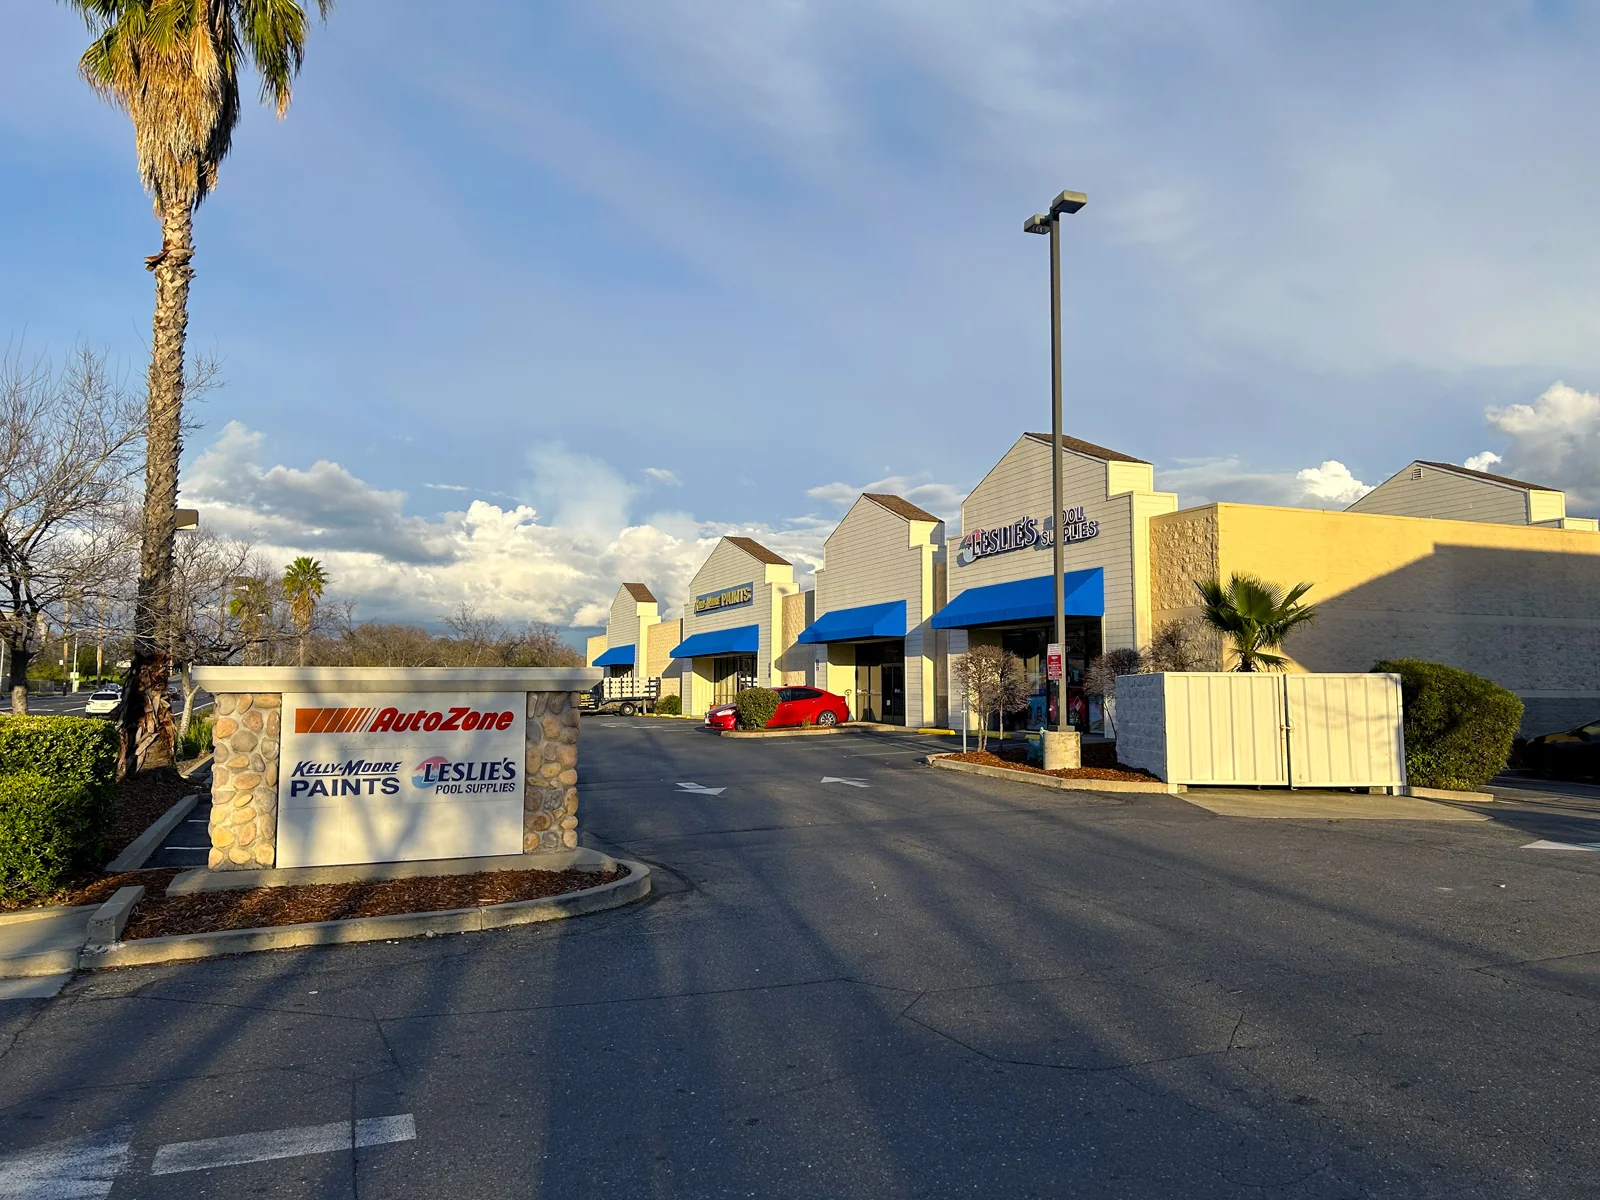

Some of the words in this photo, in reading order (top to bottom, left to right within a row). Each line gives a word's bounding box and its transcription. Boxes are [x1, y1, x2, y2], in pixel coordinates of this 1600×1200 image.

[971, 516, 1039, 556] LESLIE'S
[1041, 520, 1099, 546] SUPLIES
[721, 587, 751, 606] PAINTS
[368, 707, 514, 732] AutoZone
[291, 760, 403, 777] KELLY-MOORE
[422, 757, 516, 784] LESLIE'S
[291, 777, 400, 797] PAINTS
[435, 784, 464, 794] POOL
[465, 782, 516, 793] SUPPLIES
